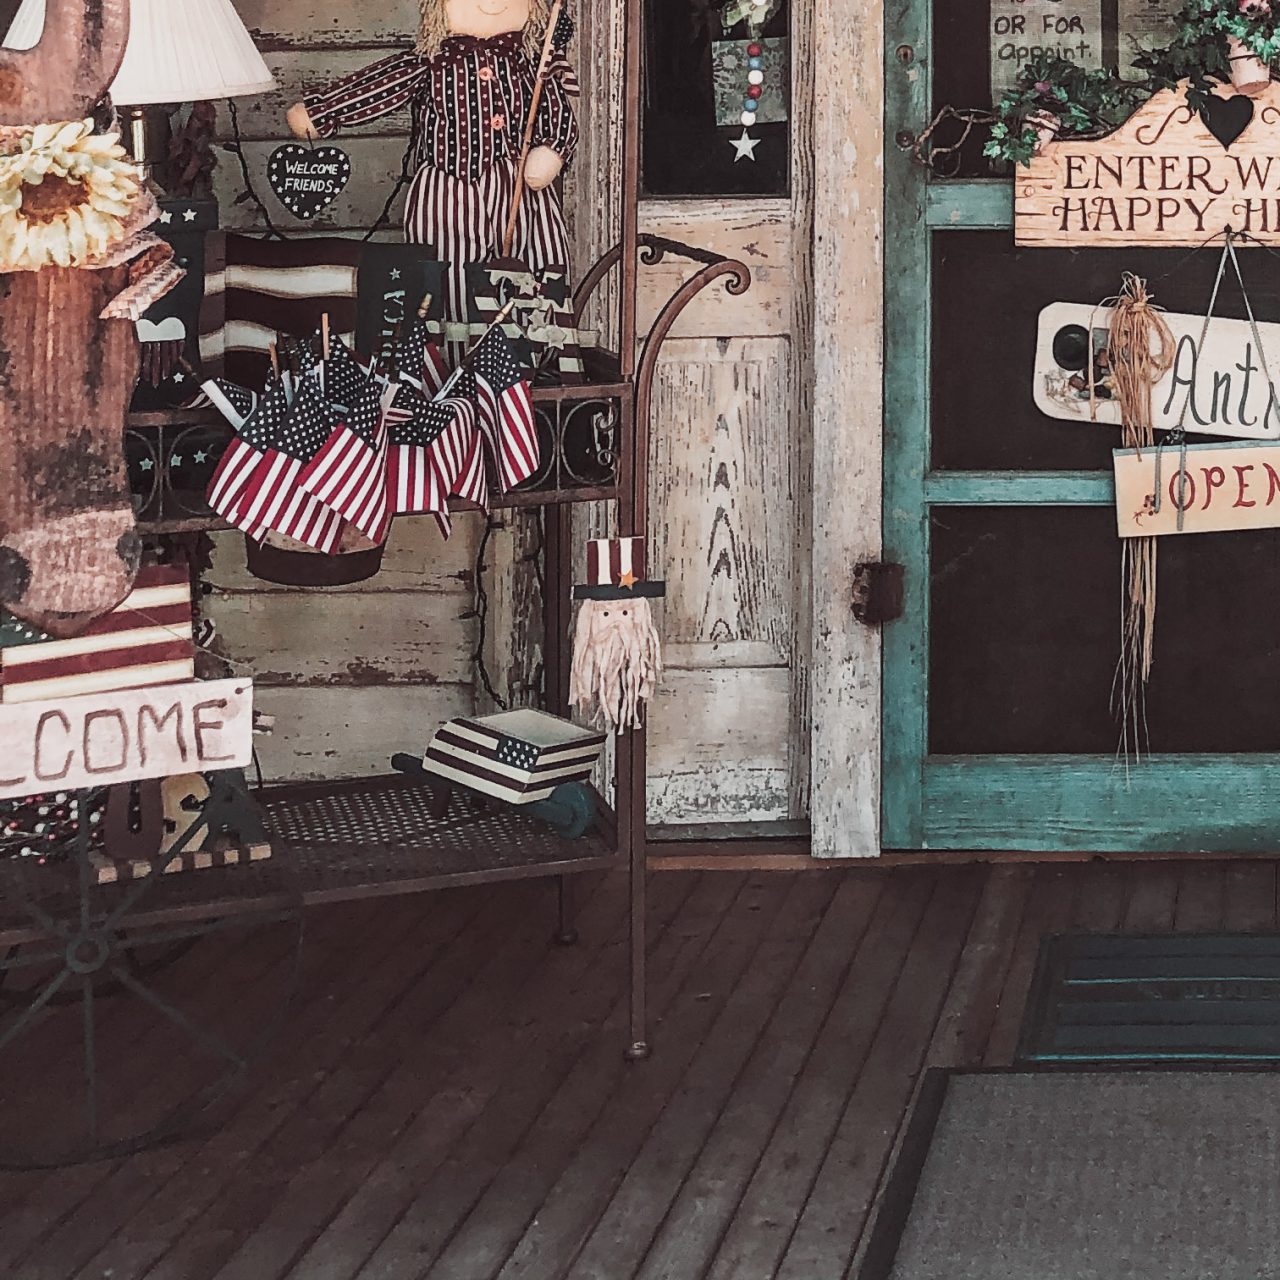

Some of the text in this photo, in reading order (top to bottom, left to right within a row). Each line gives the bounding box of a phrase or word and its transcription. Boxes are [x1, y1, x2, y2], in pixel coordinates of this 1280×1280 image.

[994, 14, 1085, 36] OR FOR
[285, 159, 339, 176] WELCOME
[1063, 154, 1229, 195] ENTER
[284, 177, 335, 194] FRIENDS
[1052, 195, 1218, 232] HAPPY
